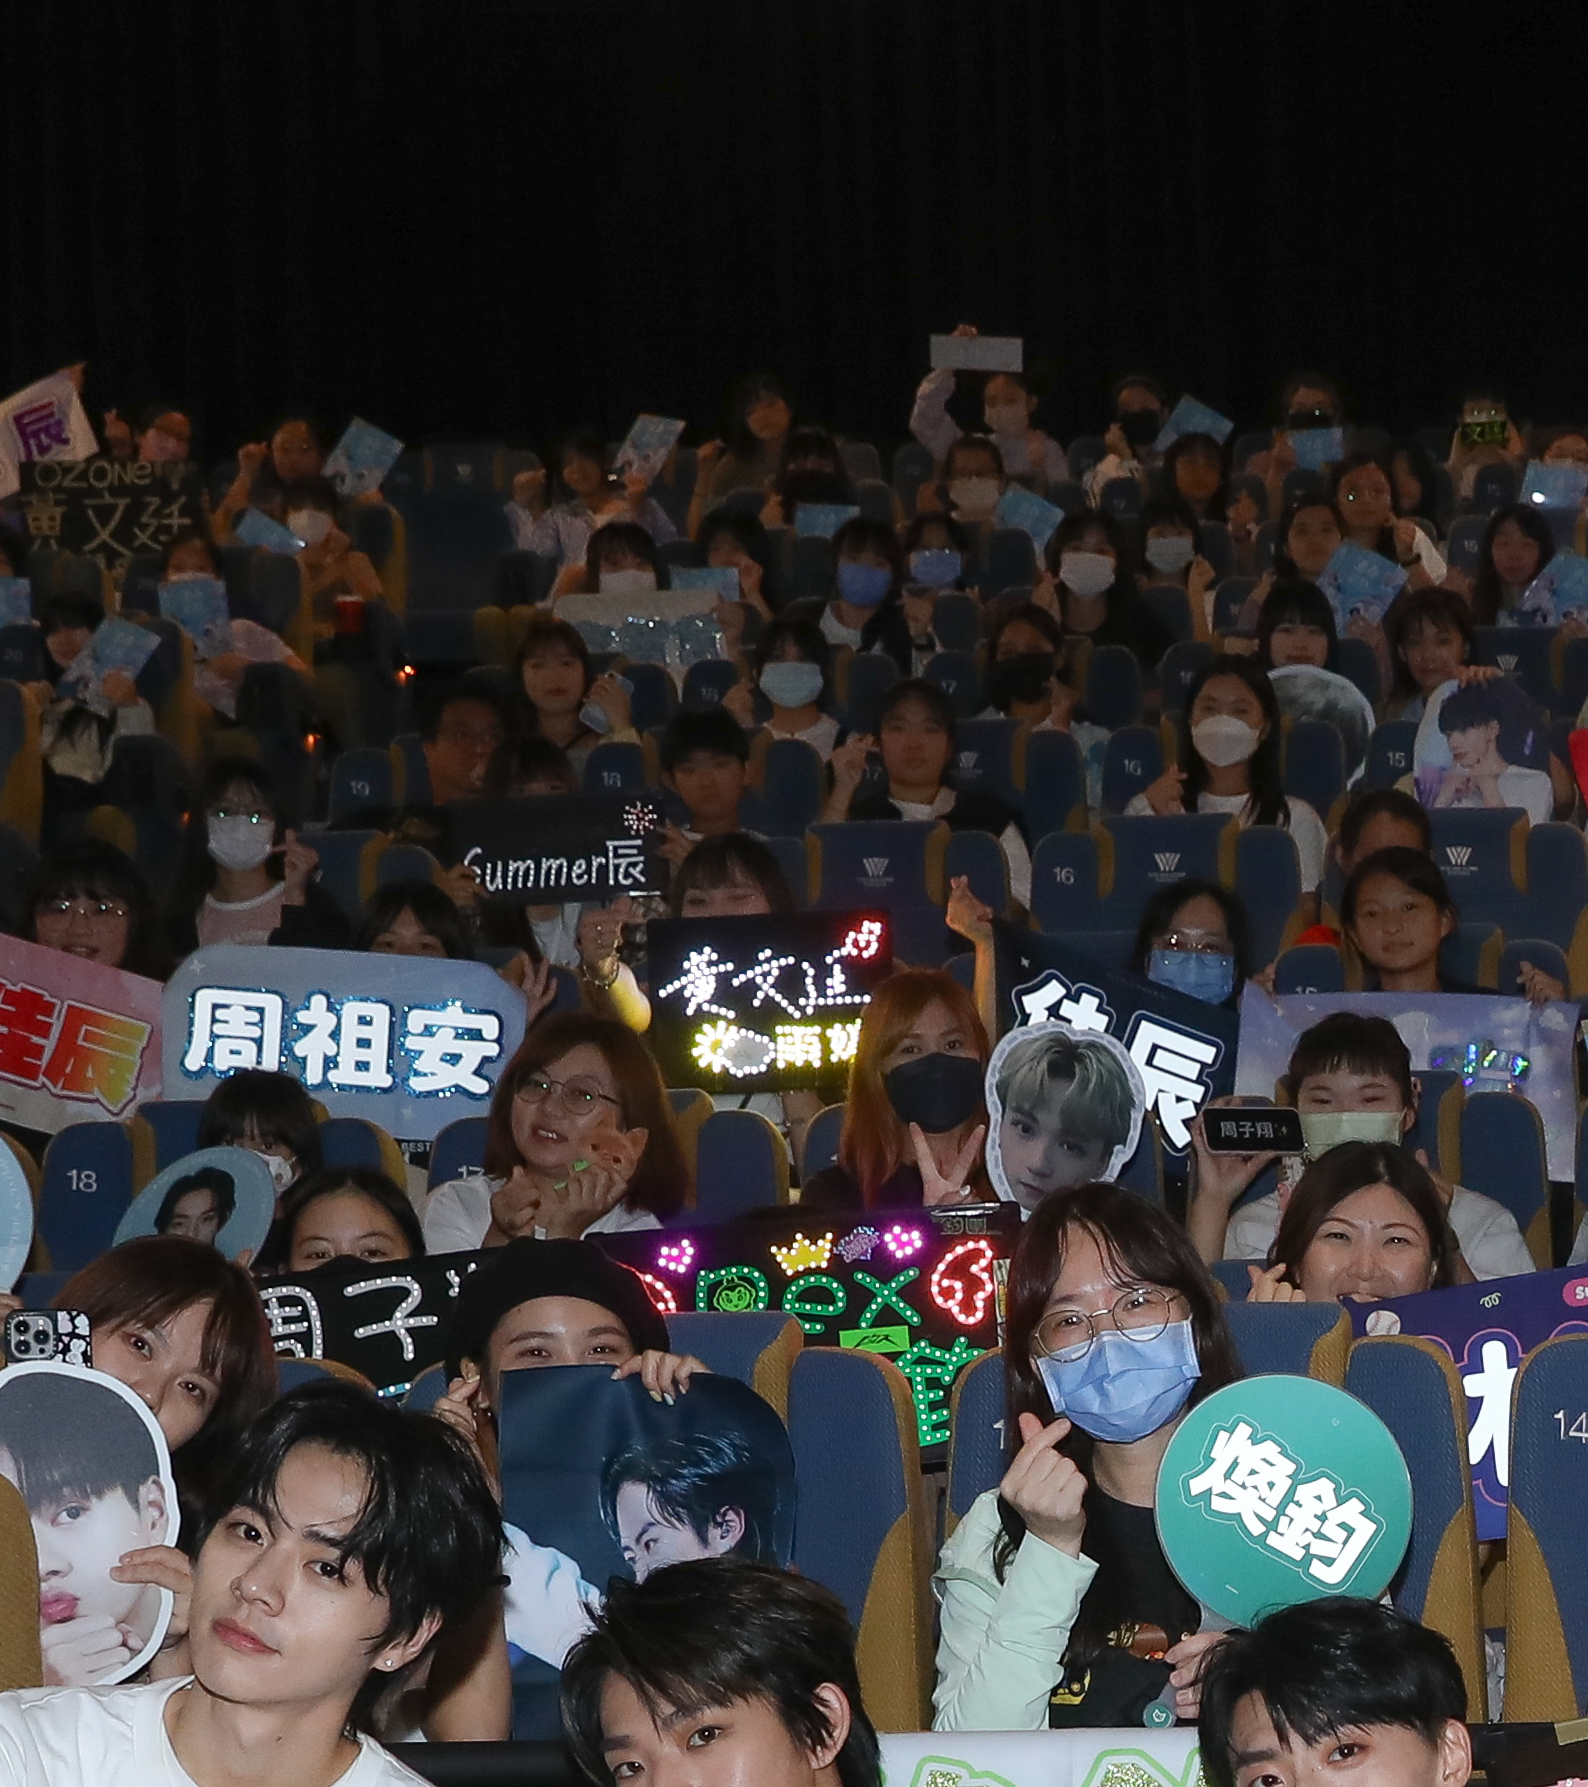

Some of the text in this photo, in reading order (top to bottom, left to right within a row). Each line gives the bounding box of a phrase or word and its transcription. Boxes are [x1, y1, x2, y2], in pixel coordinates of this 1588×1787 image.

[1387, 751, 1405, 768] 15
[1053, 866, 1074, 885] 16
[186, 988, 503, 1097] 周祖安
[1219, 1121, 1274, 1138] 周子翔
[66, 1169, 98, 1192] 18
[1189, 1420, 1378, 1585] 煥鈞
